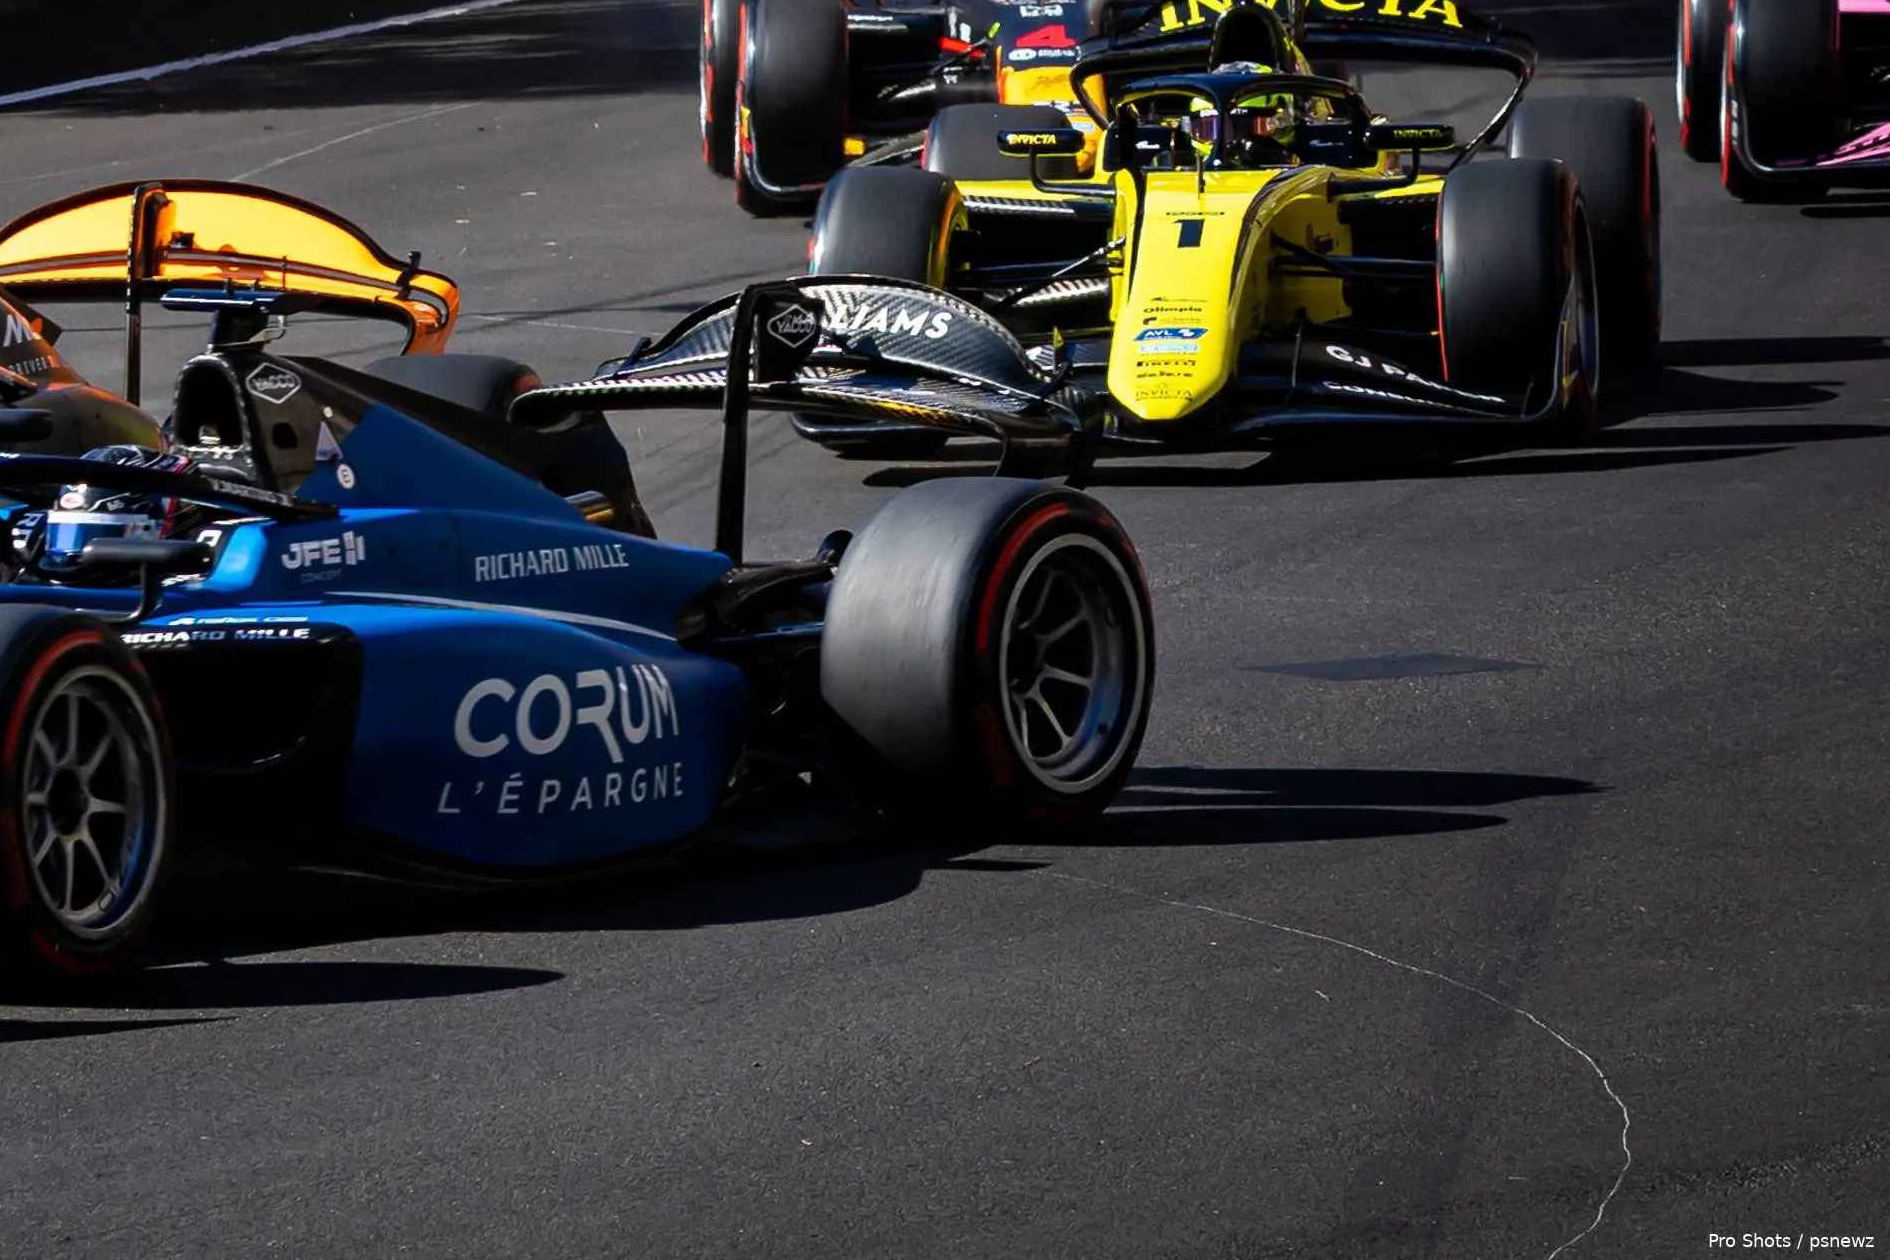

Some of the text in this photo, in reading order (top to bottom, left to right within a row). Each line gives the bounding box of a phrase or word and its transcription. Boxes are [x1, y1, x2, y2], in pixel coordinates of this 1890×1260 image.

[1014, 24, 1077, 49] 4
[1007, 131, 1058, 146] INVICTA
[1393, 128, 1444, 141] INVICTA
[1174, 218, 1206, 249] 1
[280, 537, 343, 570] JFE
[474, 543, 631, 583] RICHARD MILLE
[233, 626, 310, 640] MILLE
[453, 663, 680, 764] CORUM
[436, 761, 684, 815] L'ÉPARGNE
